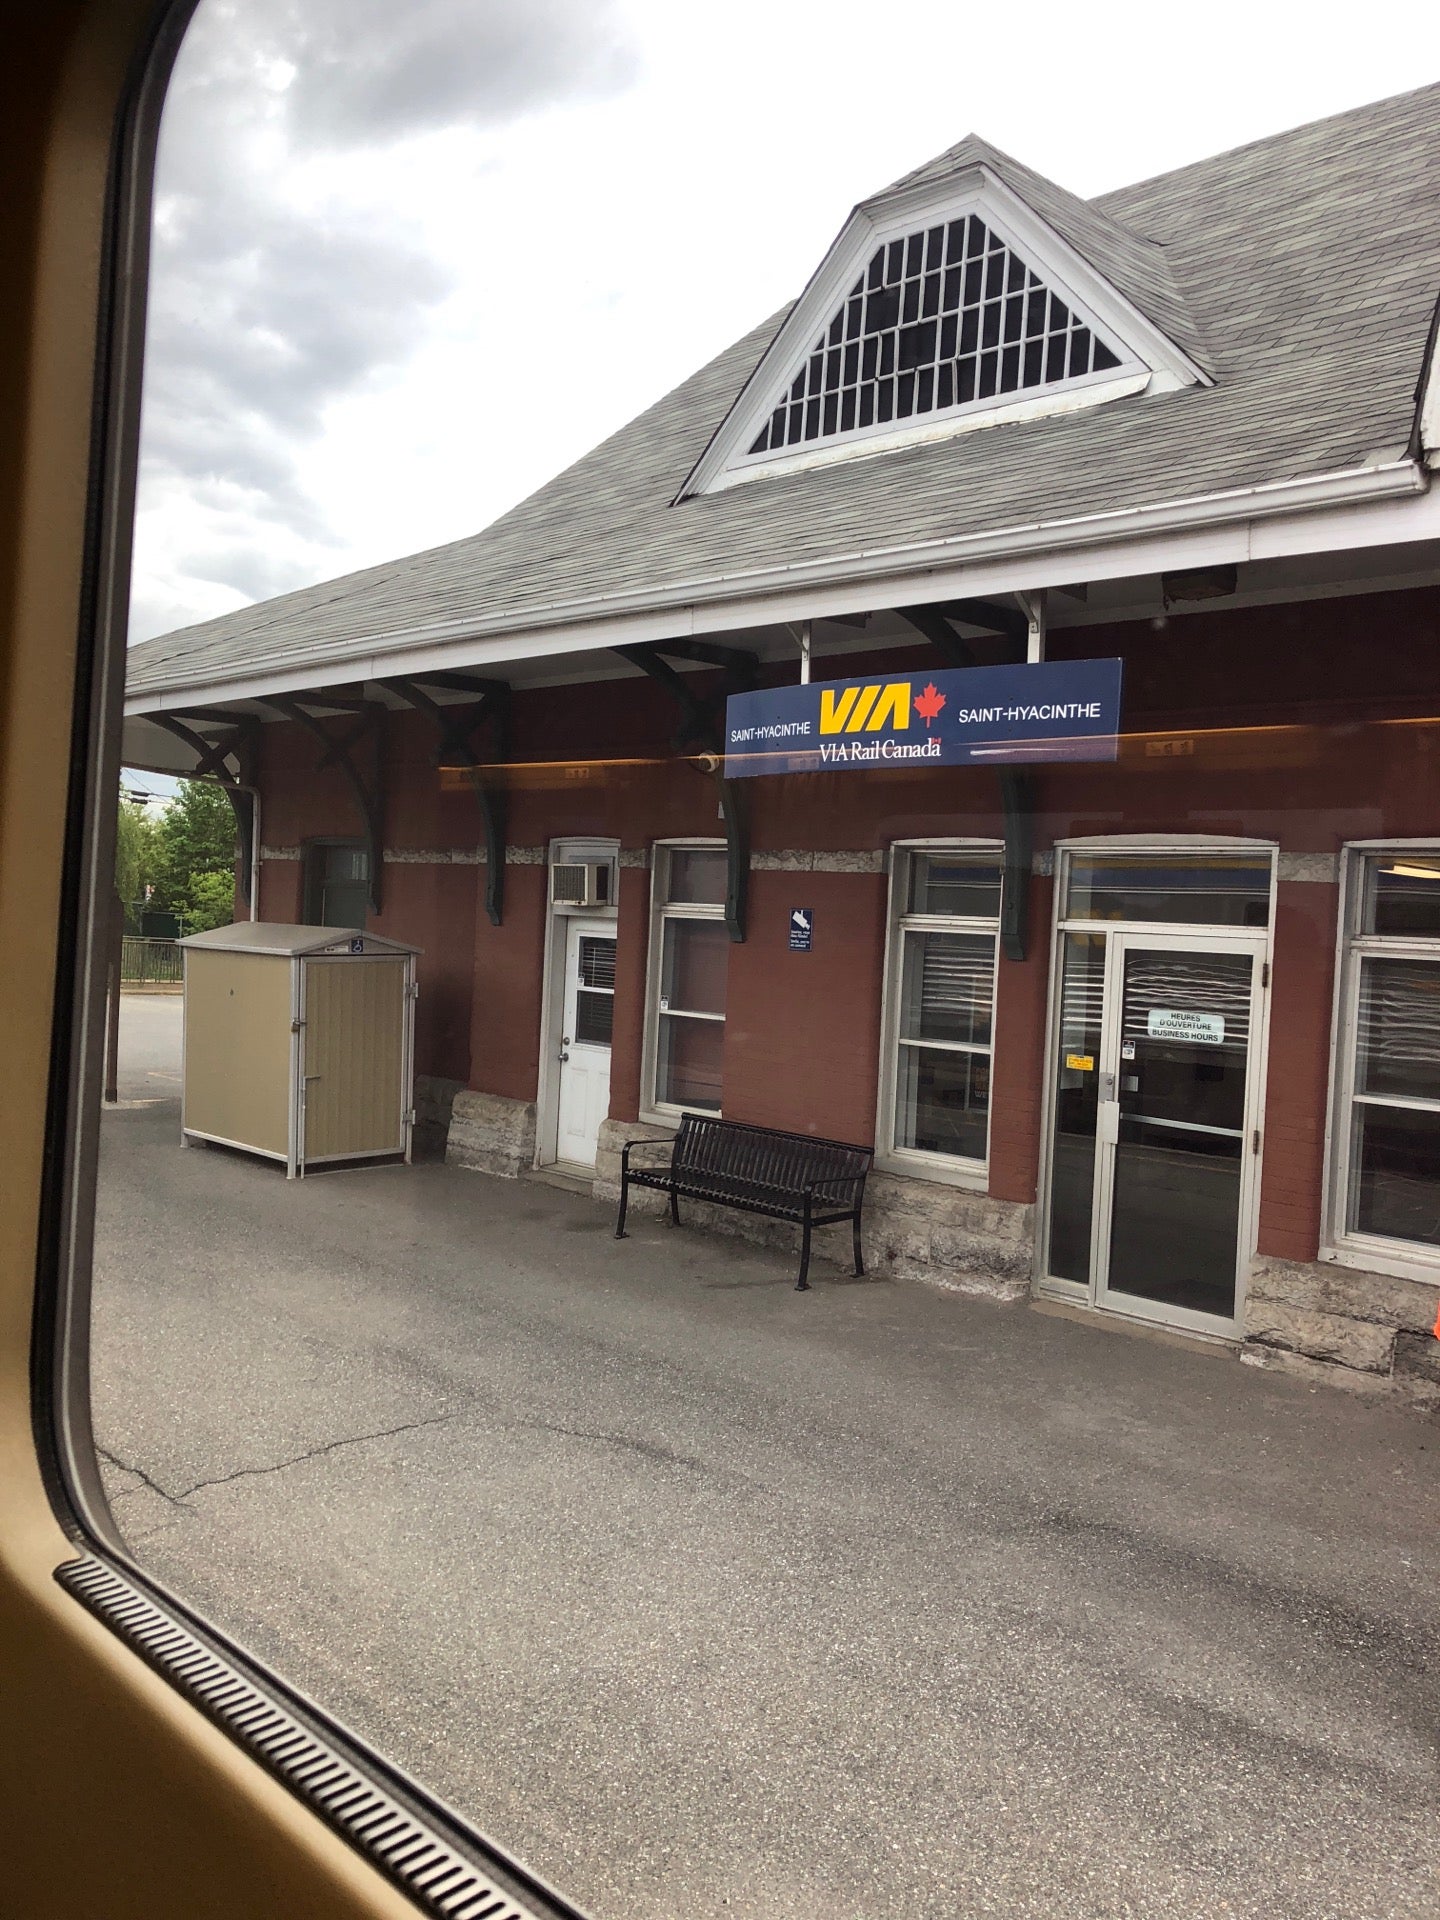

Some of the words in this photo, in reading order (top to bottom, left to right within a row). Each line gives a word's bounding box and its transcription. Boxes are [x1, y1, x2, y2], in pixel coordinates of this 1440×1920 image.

[820, 682, 911, 735] VIA
[959, 702, 1101, 723] SAINT-HYACINTHE
[731, 721, 811, 742] SAINT-HYACINTHE
[819, 743, 849, 762] VIA
[851, 741, 880, 761] Rail
[881, 738, 941, 759] Canada
[1171, 1013, 1201, 1022] HEURES
[1152, 1029, 1189, 1038] BUSINESS
[1191, 1033, 1218, 1042] HOURS
